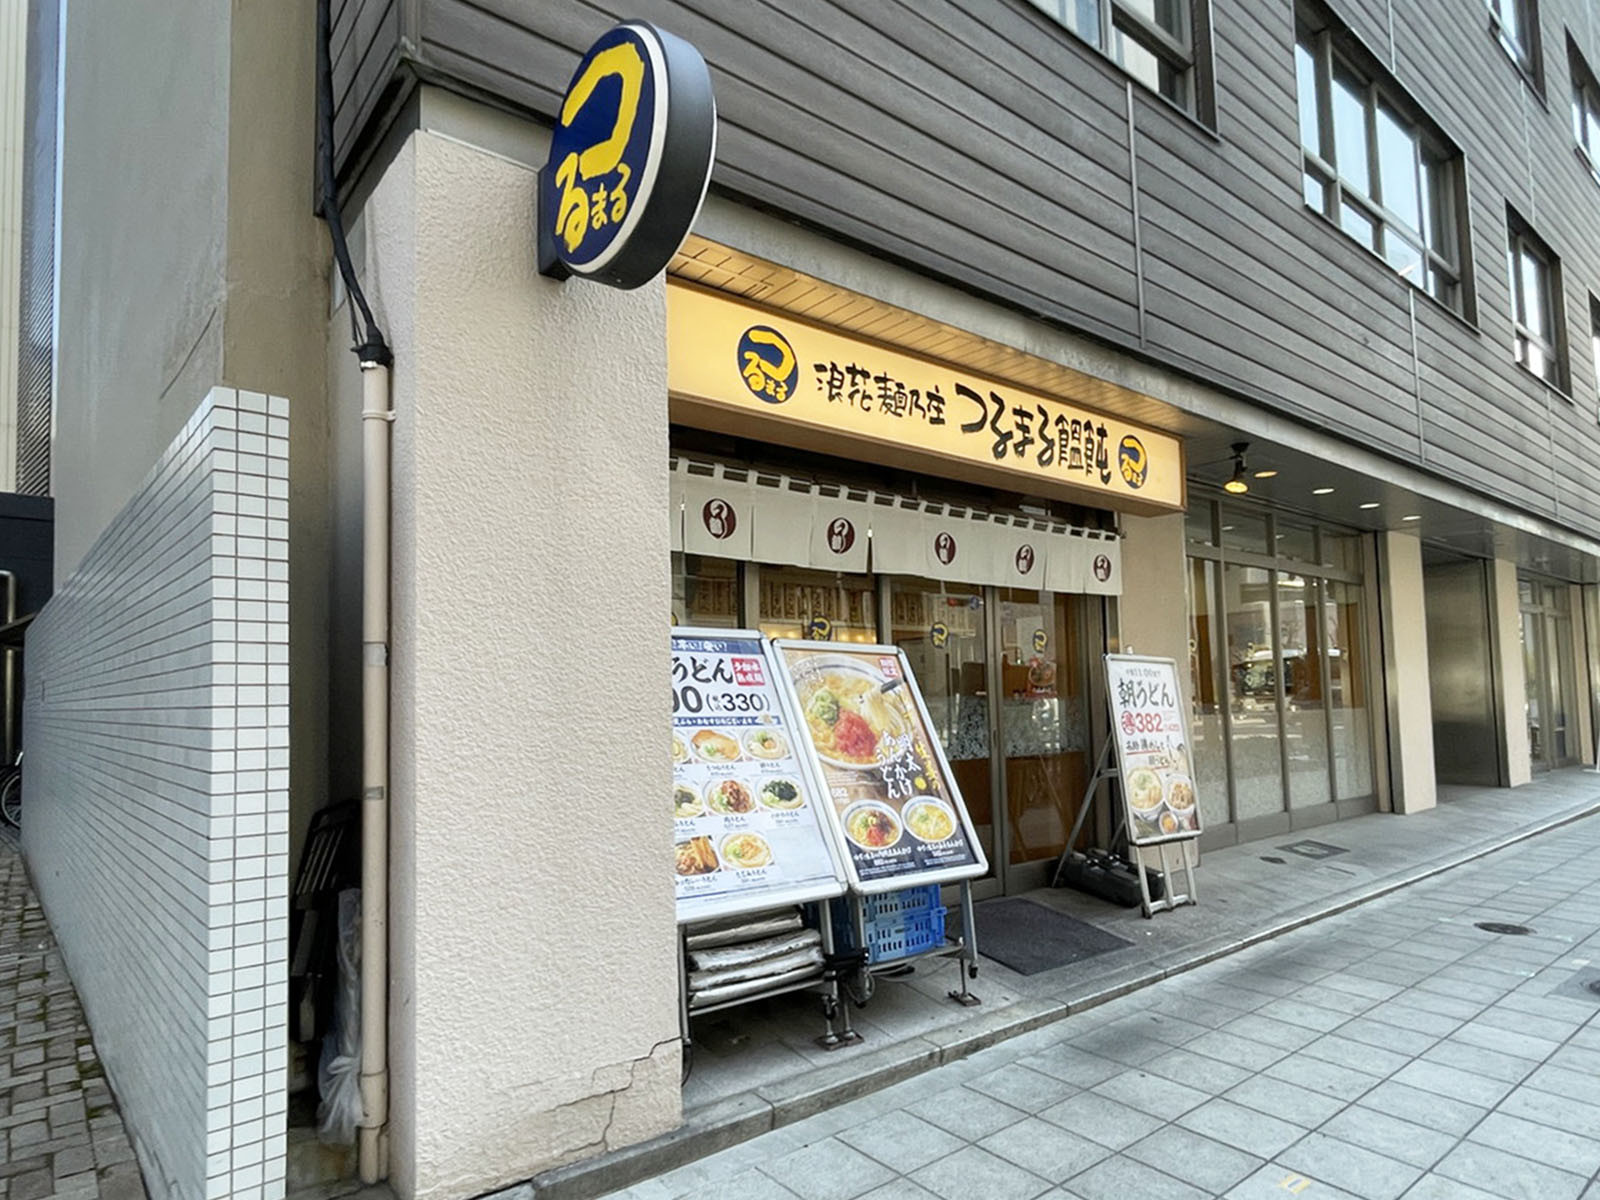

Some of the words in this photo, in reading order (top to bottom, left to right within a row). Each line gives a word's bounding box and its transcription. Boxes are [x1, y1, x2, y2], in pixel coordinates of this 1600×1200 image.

[556, 42, 645, 253] つるまる
[743, 329, 796, 402] つるまる
[1118, 677, 1175, 709] 朝うどん
[1135, 712, 1164, 733] 382
